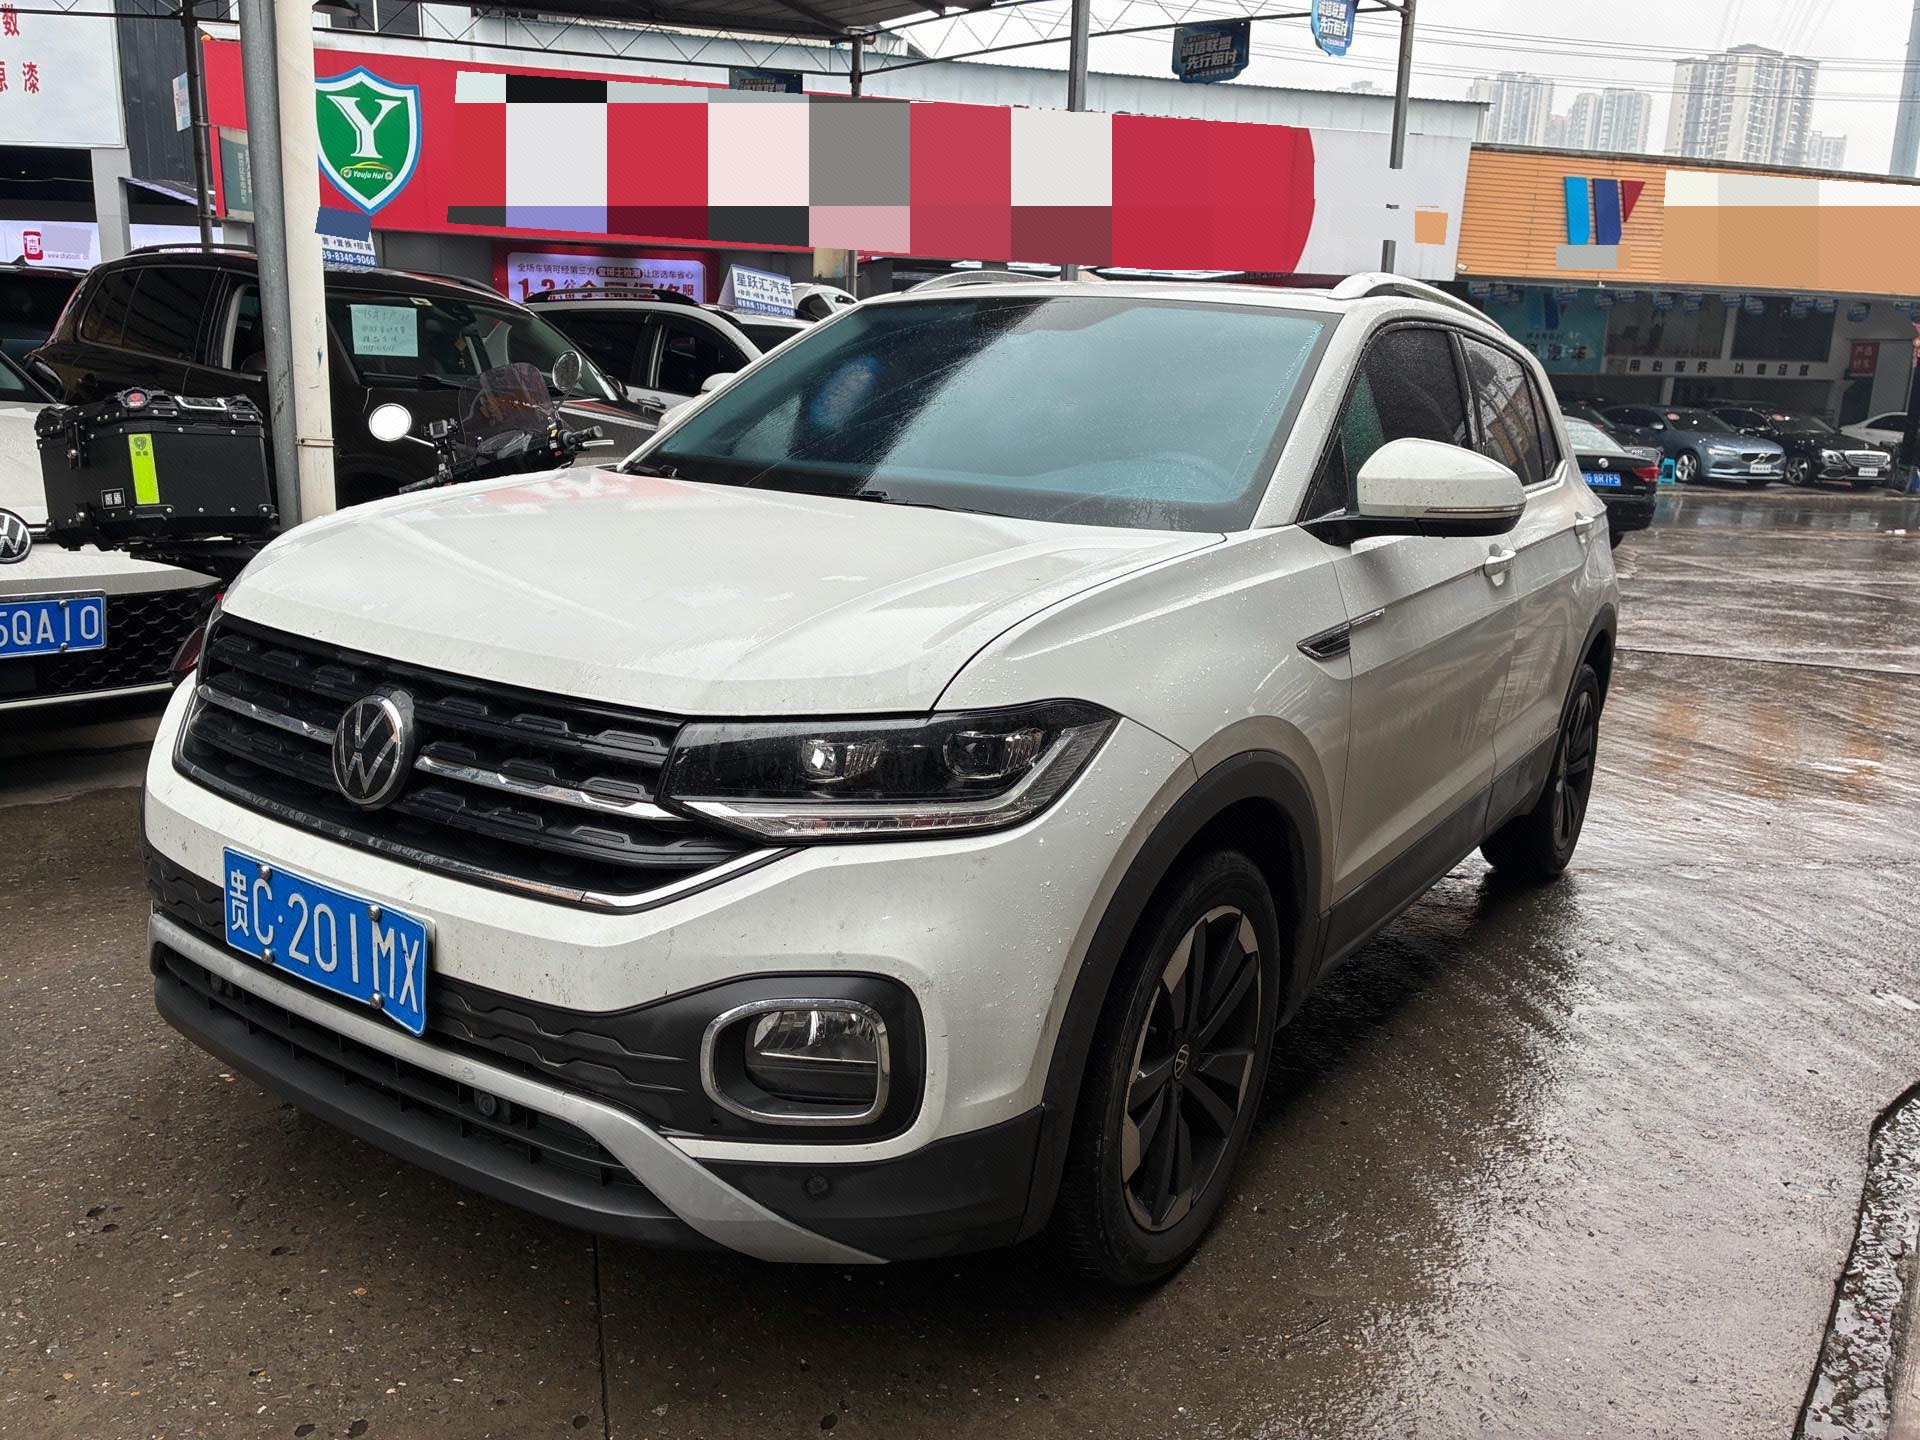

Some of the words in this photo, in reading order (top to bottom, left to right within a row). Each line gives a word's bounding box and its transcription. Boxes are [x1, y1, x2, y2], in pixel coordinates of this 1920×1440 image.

[1182, 36, 1232, 56] 诚信联盟
[1187, 49, 1238, 70] 先行赔付
[326, 95, 401, 158] Y
[737, 272, 790, 296] 星跃汇汽车
